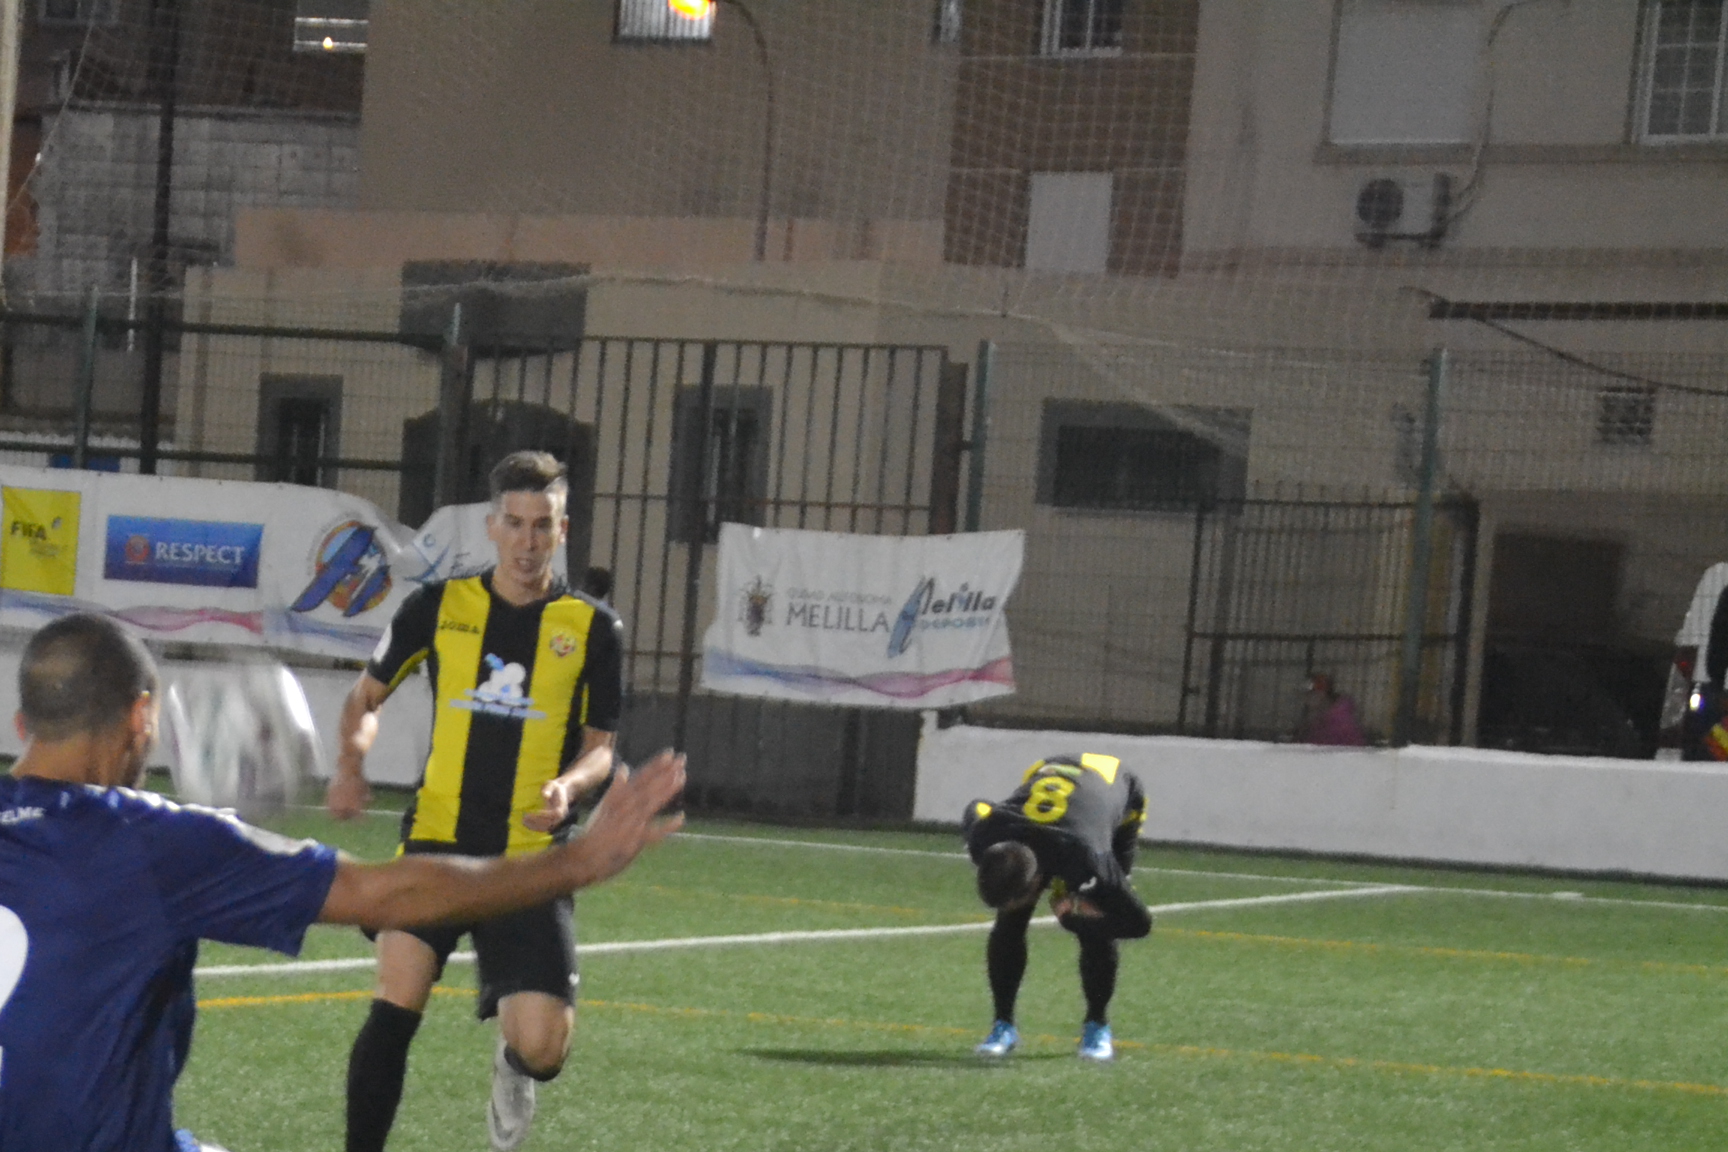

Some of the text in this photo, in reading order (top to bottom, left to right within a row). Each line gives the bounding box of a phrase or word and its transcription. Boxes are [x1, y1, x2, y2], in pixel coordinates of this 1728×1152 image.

[10, 520, 48, 541] FIFA
[155, 541, 246, 566] RESPECT
[785, 602, 890, 633] MELILLA
[1022, 776, 1076, 824] 8
